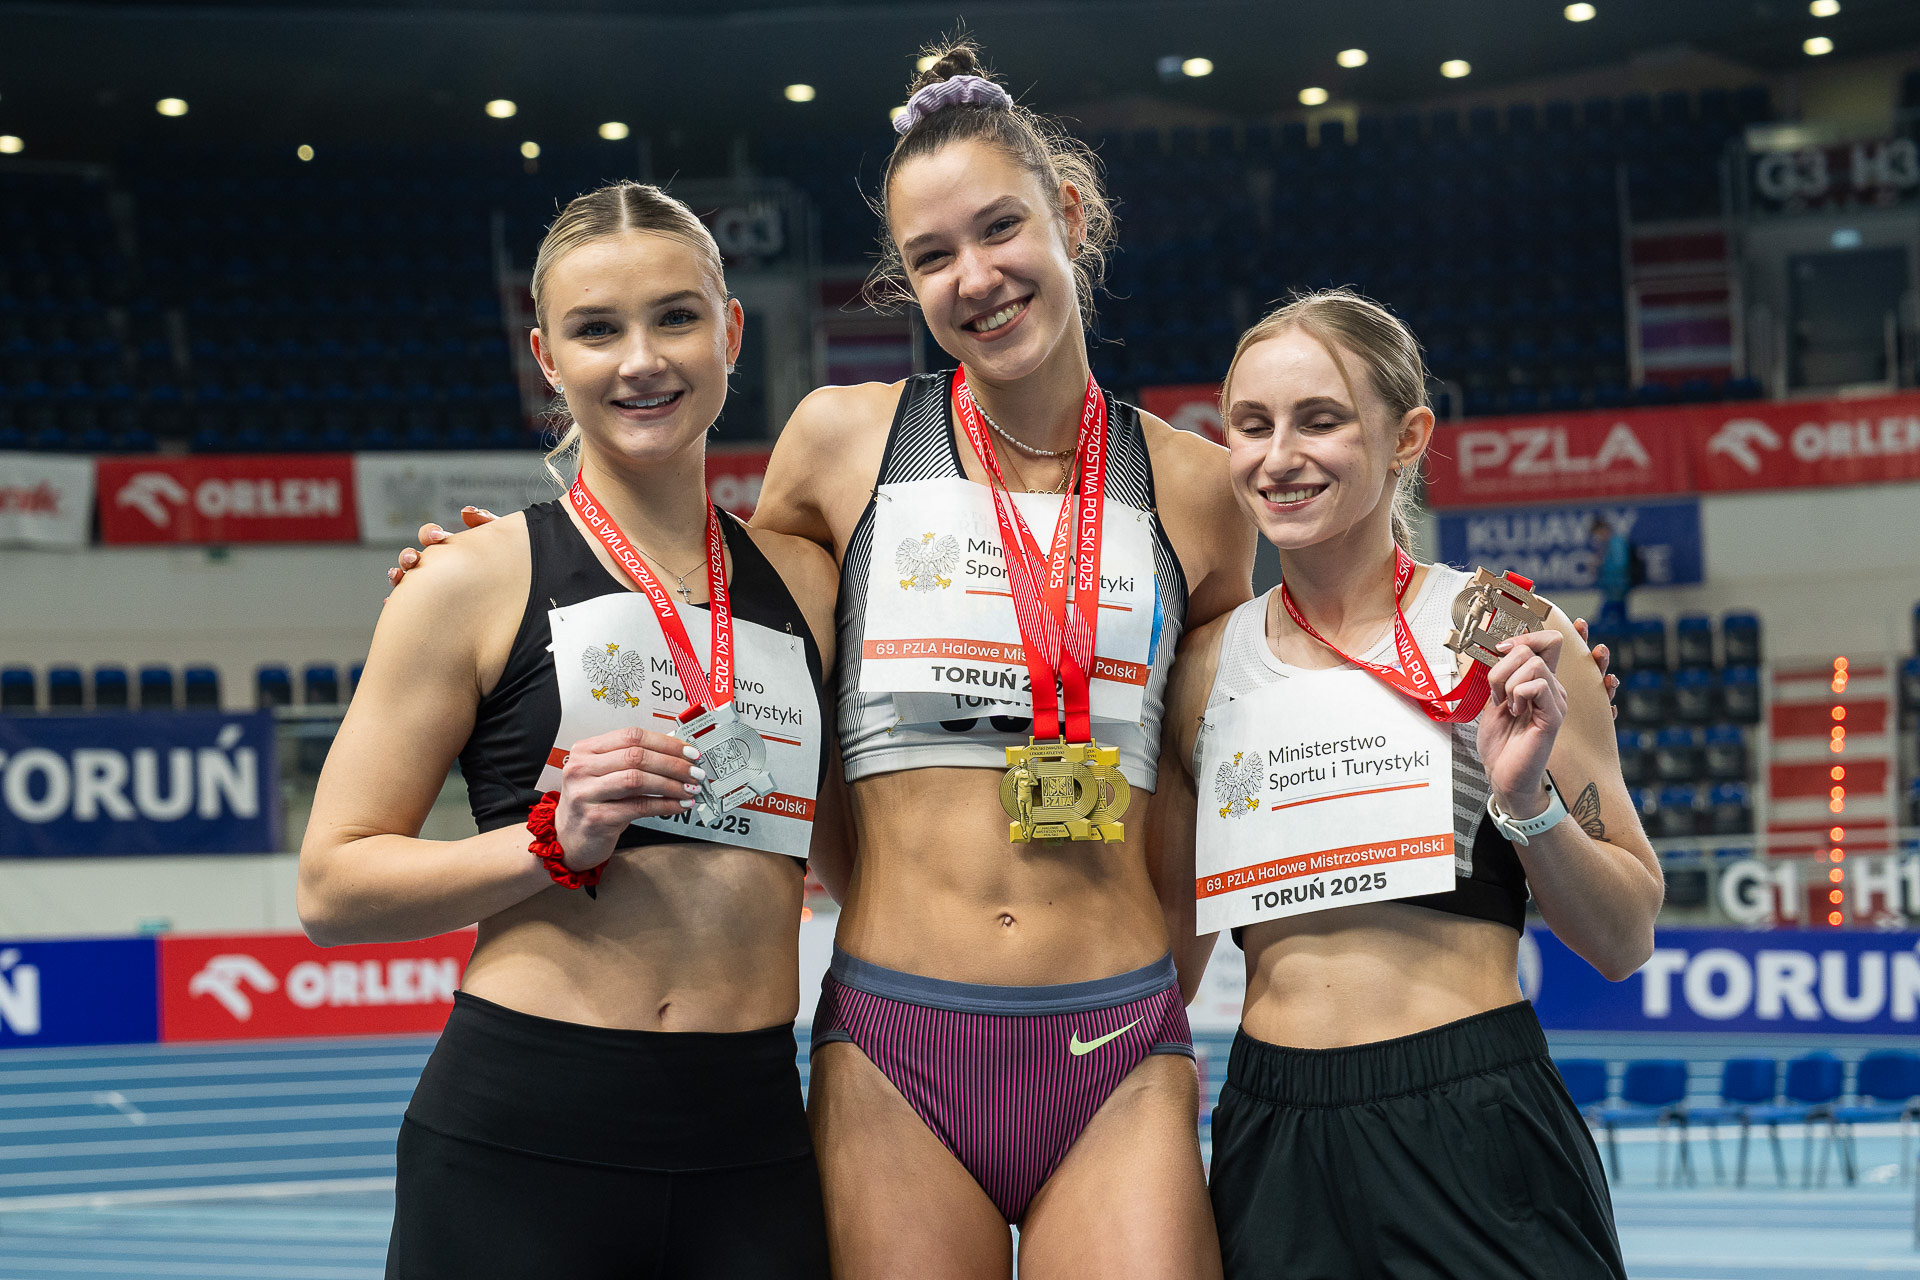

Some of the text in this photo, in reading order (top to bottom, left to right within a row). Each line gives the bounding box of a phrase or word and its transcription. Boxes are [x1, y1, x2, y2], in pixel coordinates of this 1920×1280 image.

[1457, 421, 1651, 478] PZLA
[194, 477, 342, 519] ORLEN
[1080, 497, 1097, 551] POLSKI
[599, 523, 674, 618] MISTRZOSTWA
[965, 558, 1009, 579] Spor
[1050, 550, 1066, 589] 2025
[1079, 554, 1094, 591] 2025
[715, 603, 730, 656] POLSKI
[714, 658, 730, 695] 2025
[875, 642, 899, 656] 69.
[902, 641, 938, 655] PZLA
[941, 641, 1000, 658] Halowe
[1094, 660, 1137, 680] Polski
[931, 665, 1016, 690] TORUŃ
[733, 696, 803, 726] urystyki
[1268, 734, 1387, 767] Ministerstwo
[1269, 750, 1430, 792] Sportu i Turystyki
[0, 723, 260, 823] ORUŃ
[766, 796, 807, 816] Polski
[1206, 837, 1445, 892] 69. PZLA Halowe Mistrzostwa Polski
[1251, 871, 1388, 912] TORUŃ 2025
[1719, 858, 1798, 924] G1
[286, 957, 461, 1009] ORLEN
